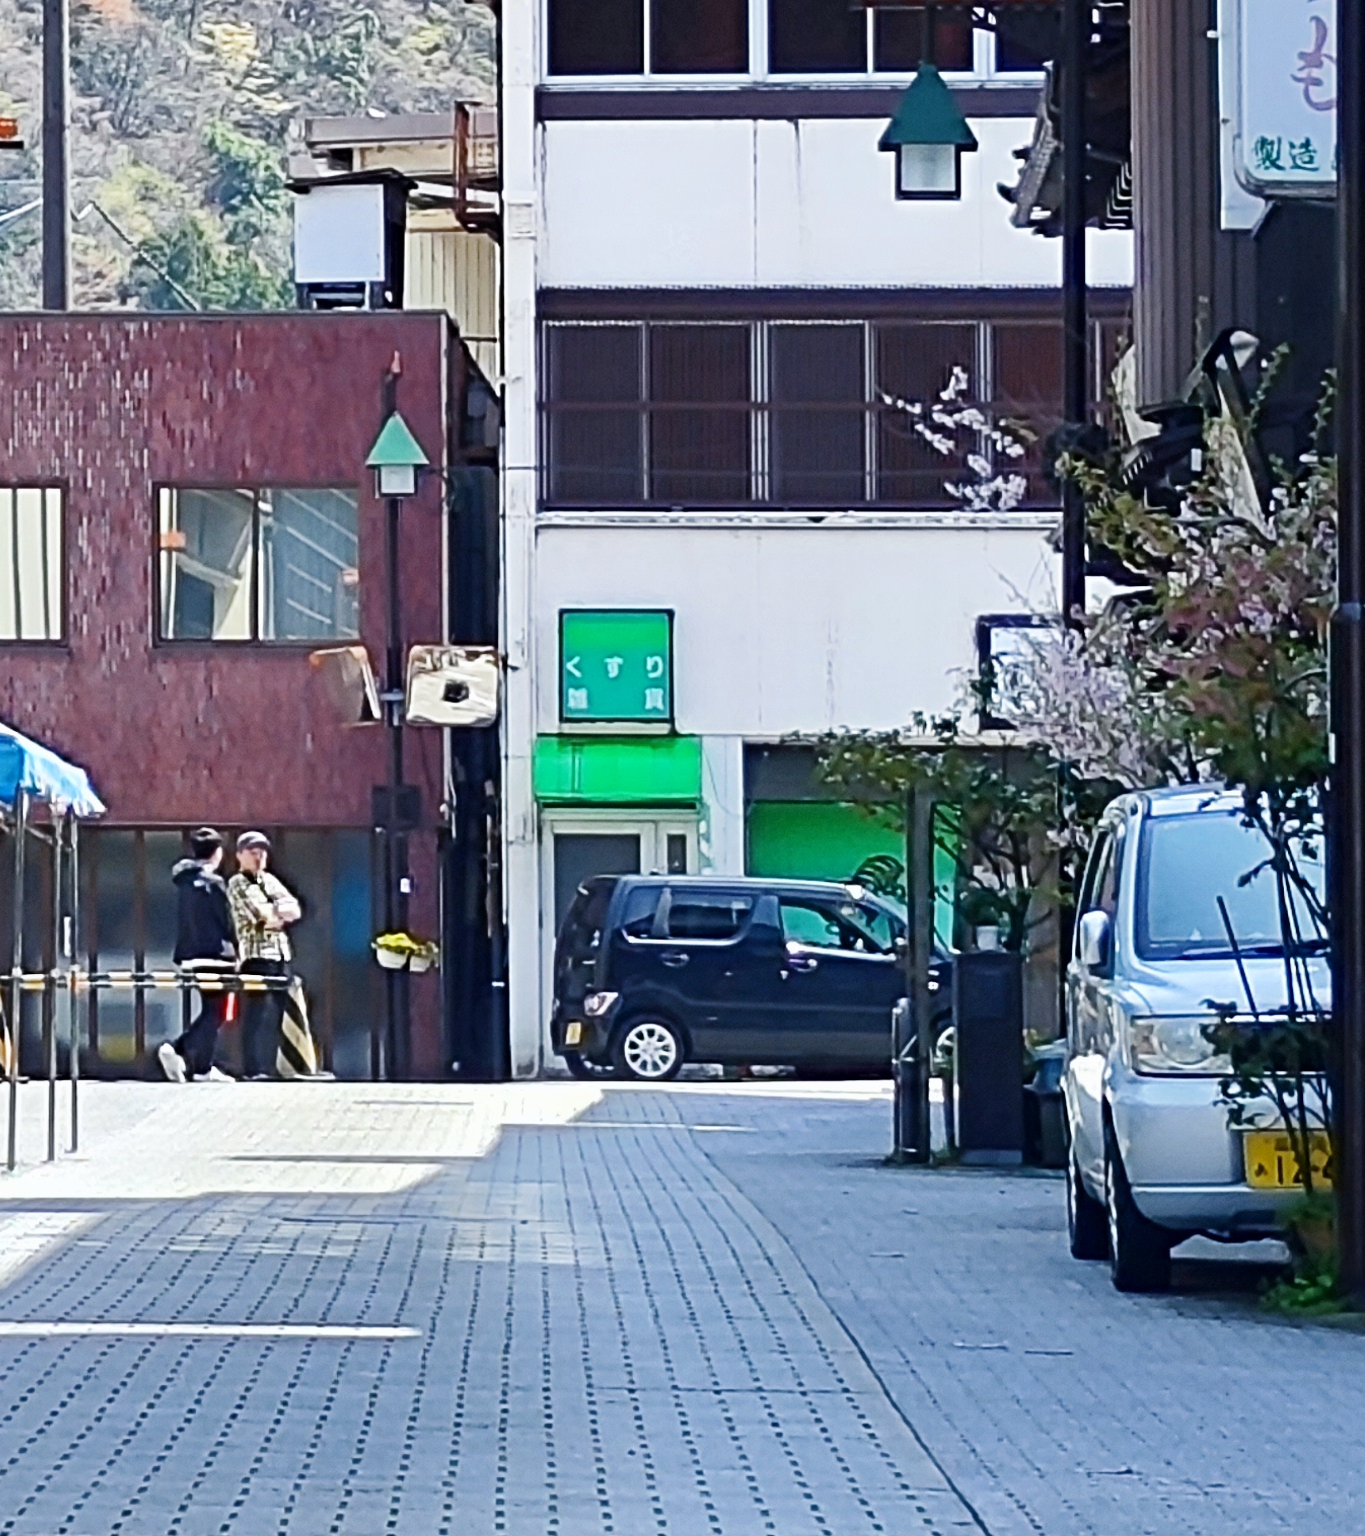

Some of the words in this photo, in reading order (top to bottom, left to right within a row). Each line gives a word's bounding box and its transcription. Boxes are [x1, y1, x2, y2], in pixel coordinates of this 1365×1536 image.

[1252, 135, 1336, 172] 製造
[566, 655, 664, 678] くすり
